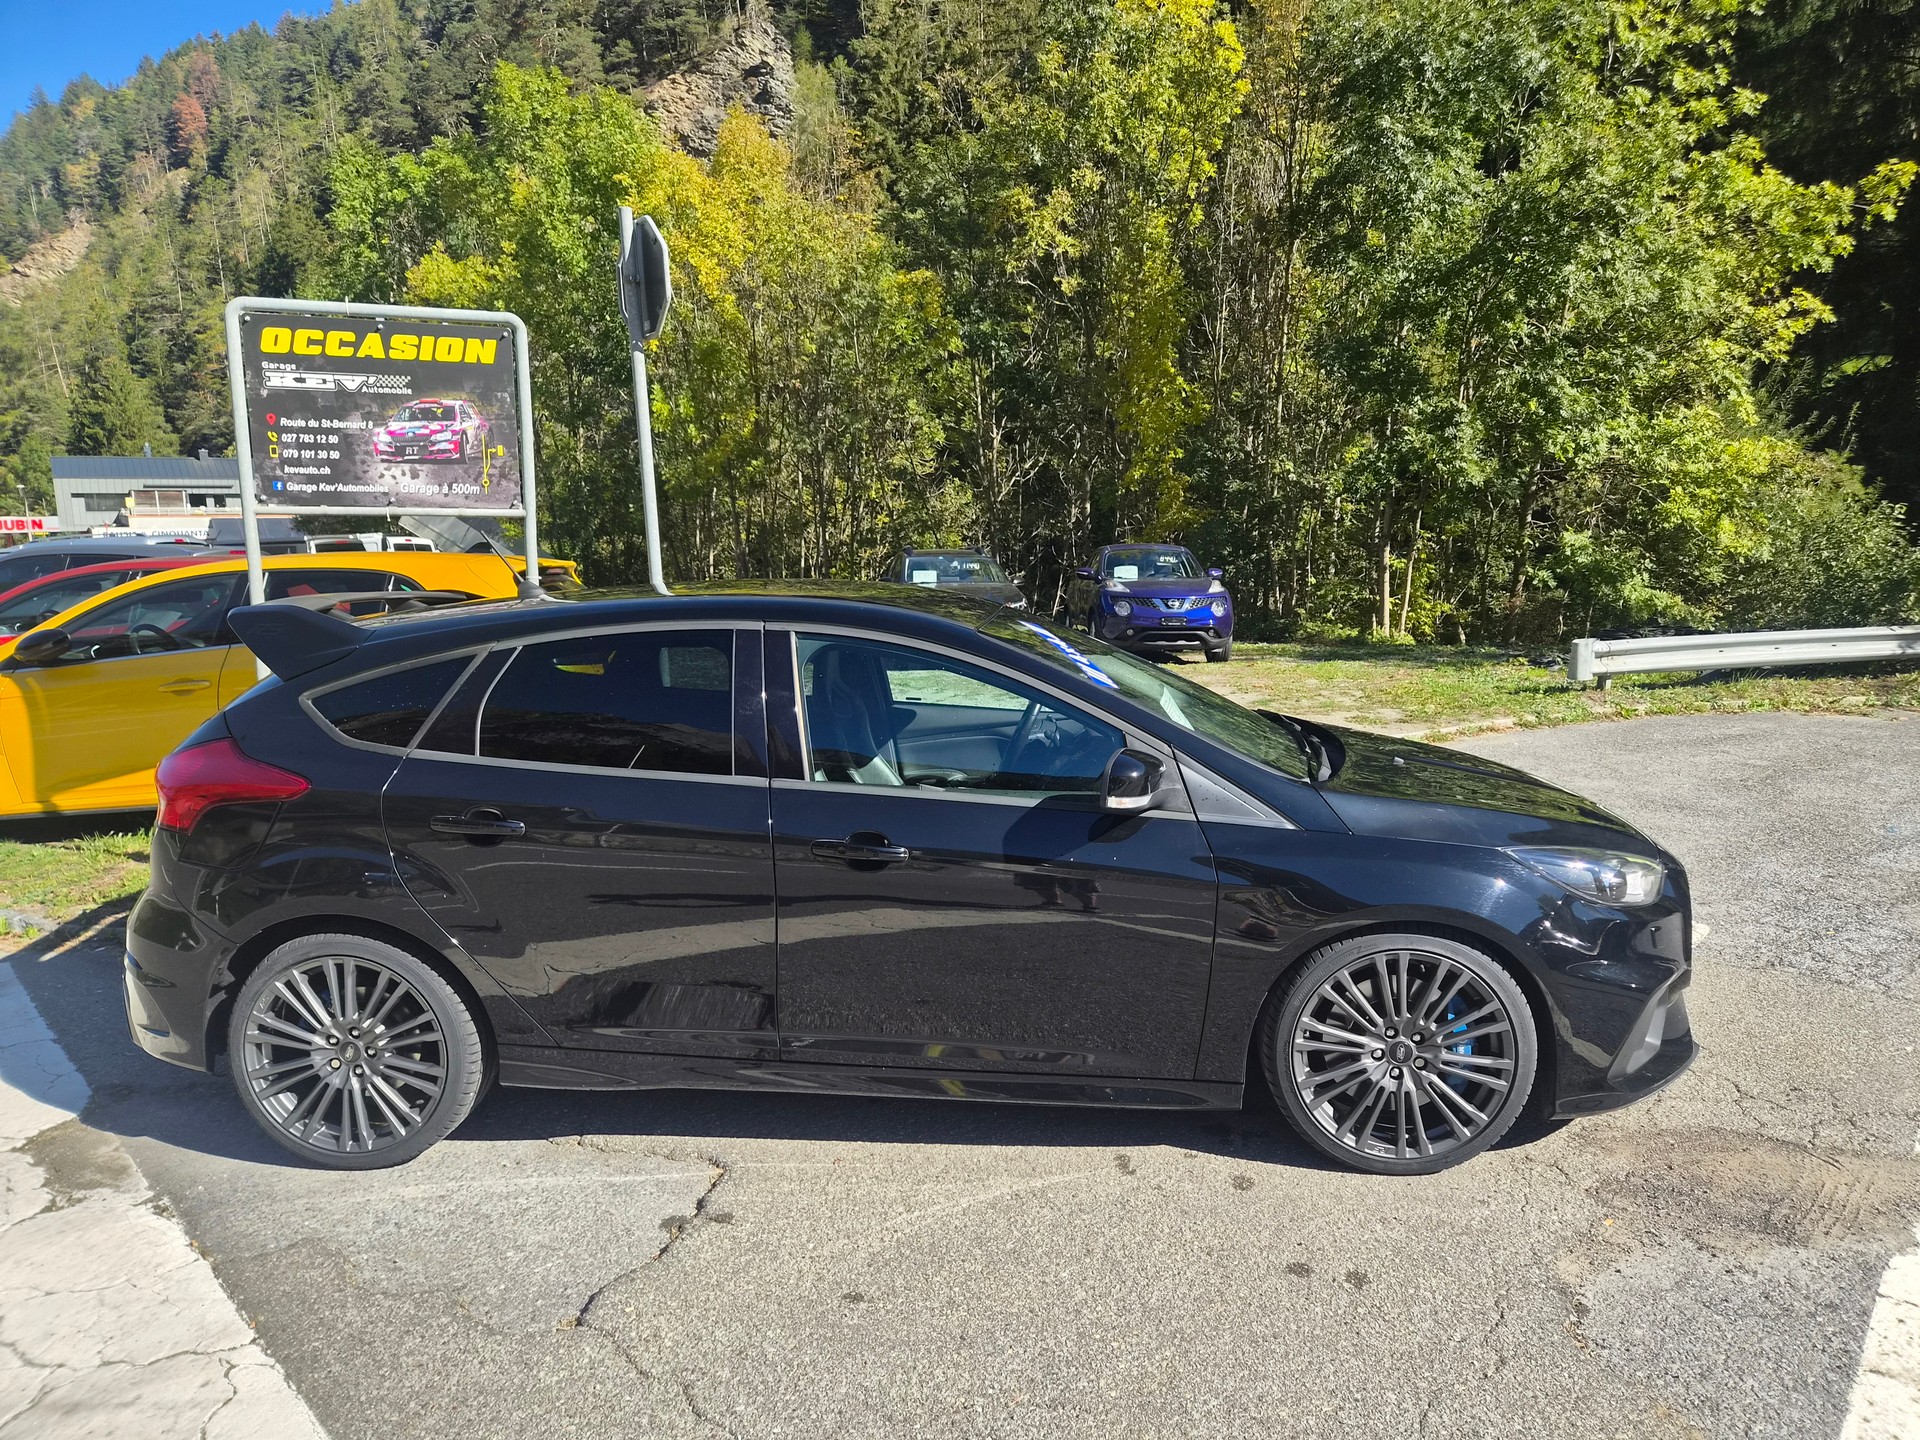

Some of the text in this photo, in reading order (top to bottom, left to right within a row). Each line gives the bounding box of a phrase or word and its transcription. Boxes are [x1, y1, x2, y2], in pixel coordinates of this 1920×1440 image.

[260, 327, 498, 365] OCCASION
[261, 361, 297, 371] Garage
[361, 386, 412, 395] Automobile
[280, 417, 374, 429] Route du St-Bernard 8
[281, 433, 338, 444] 027 783 12 50
[283, 449, 340, 459] 079 101 30 50
[405, 446, 419, 455] RT
[284, 464, 331, 475] kevauto.ch
[286, 481, 389, 493] Garage Kev'Automobiles
[400, 482, 480, 496] Garage à 500m
